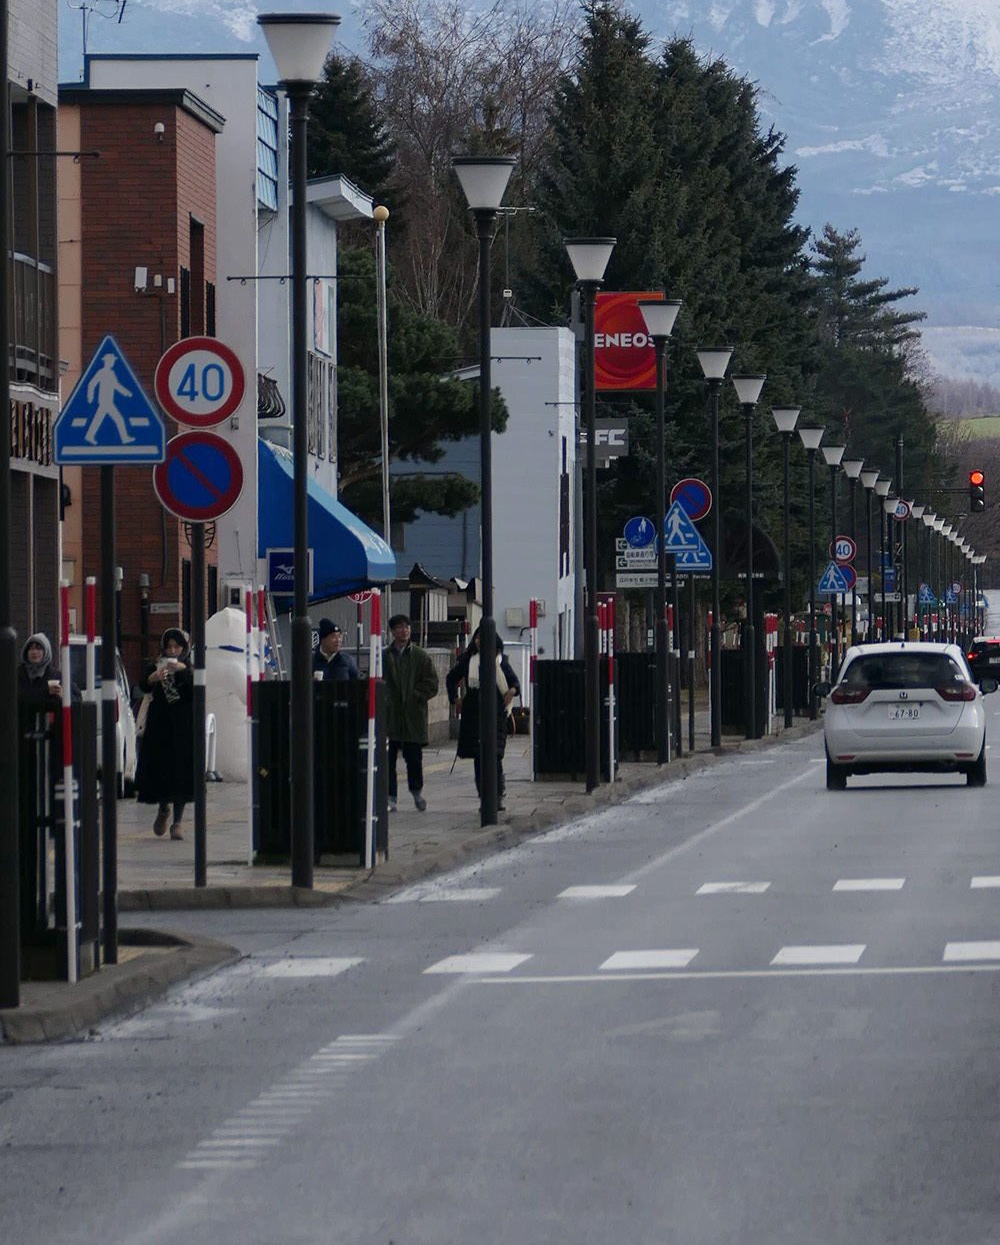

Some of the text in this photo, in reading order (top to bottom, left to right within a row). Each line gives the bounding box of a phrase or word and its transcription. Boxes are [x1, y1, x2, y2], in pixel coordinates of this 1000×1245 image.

[176, 362, 225, 402] 40
[896, 505, 907, 515] 40
[836, 544, 850, 556] 40
[895, 709, 919, 718] 67-80
